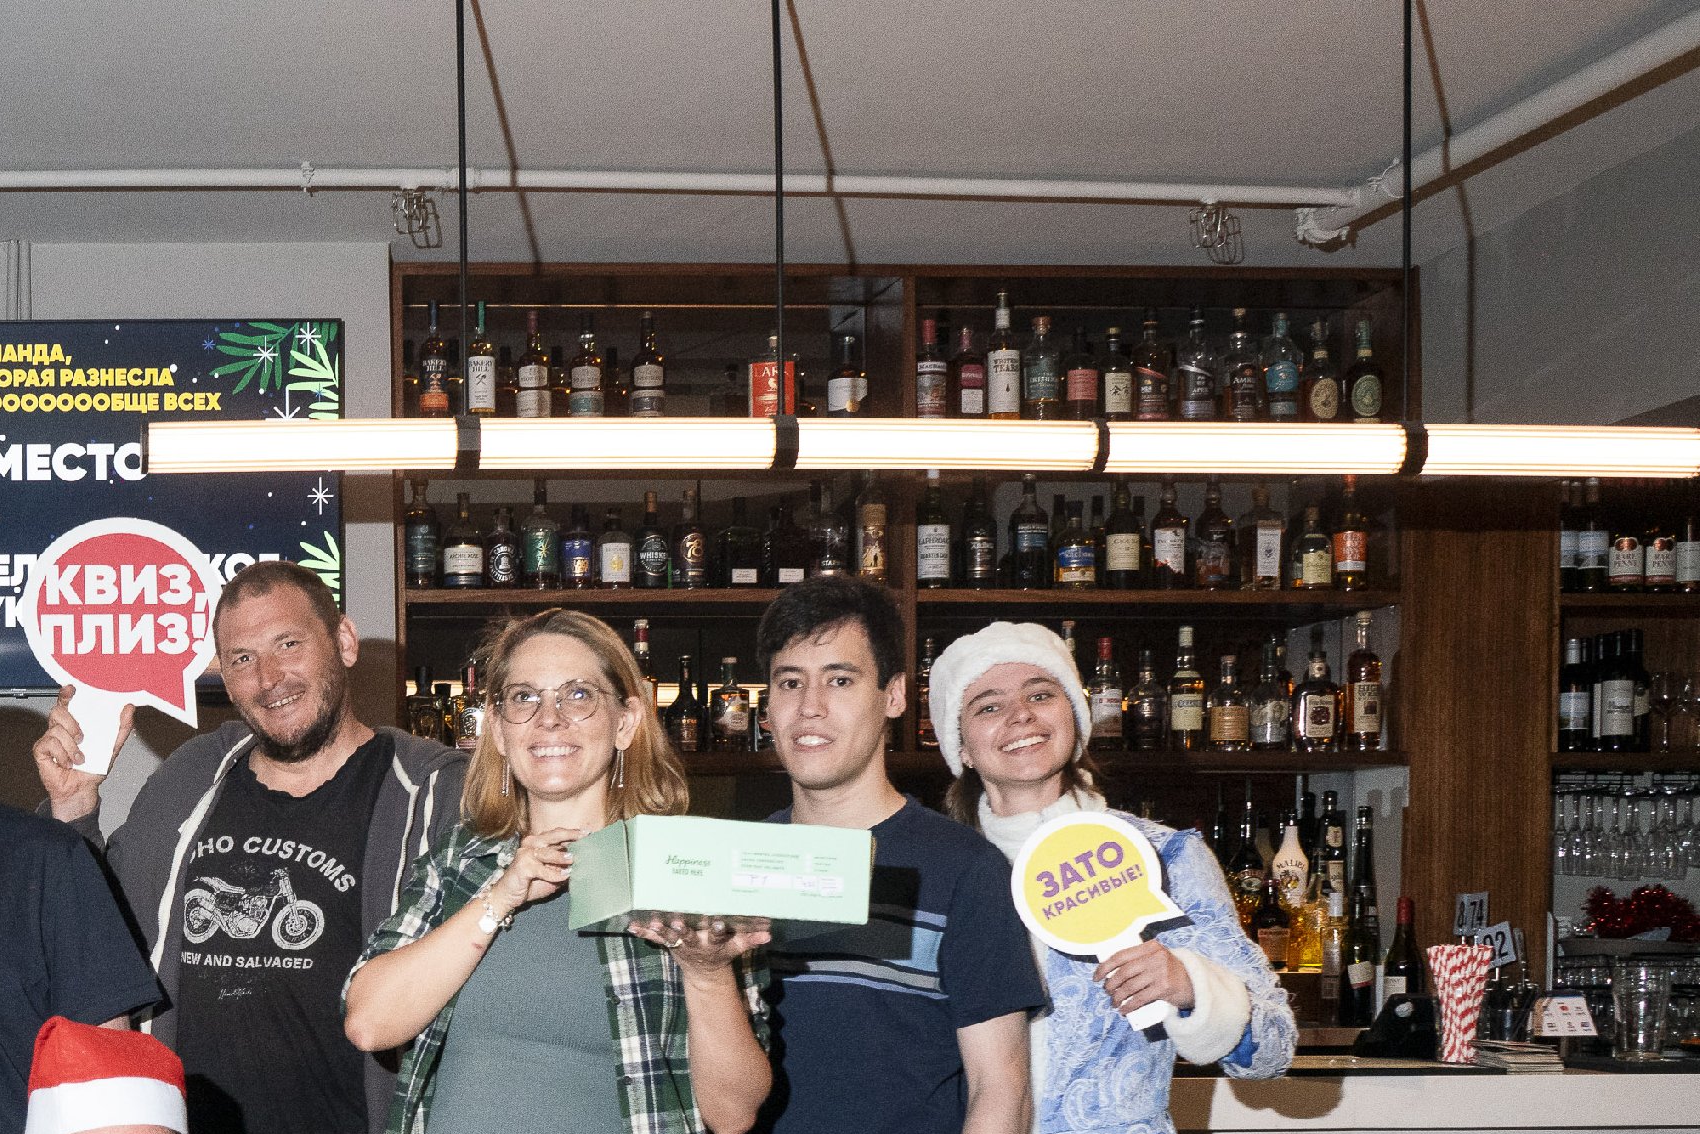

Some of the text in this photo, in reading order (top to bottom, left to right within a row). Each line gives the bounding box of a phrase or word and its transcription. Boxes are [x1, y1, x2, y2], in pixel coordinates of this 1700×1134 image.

[60, 367, 175, 387] РАЗНЕСЛА
[163, 392, 221, 411] ВСЕХ
[41, 613, 207, 655] ПЛИЗ!
[190, 836, 356, 893] HO CUSTOMS
[1036, 841, 1124, 898] ЗАТО
[1041, 864, 1144, 921] КРАСИВЫЕ!
[204, 955, 232, 967] AND
[236, 956, 314, 969] SALVAGED
